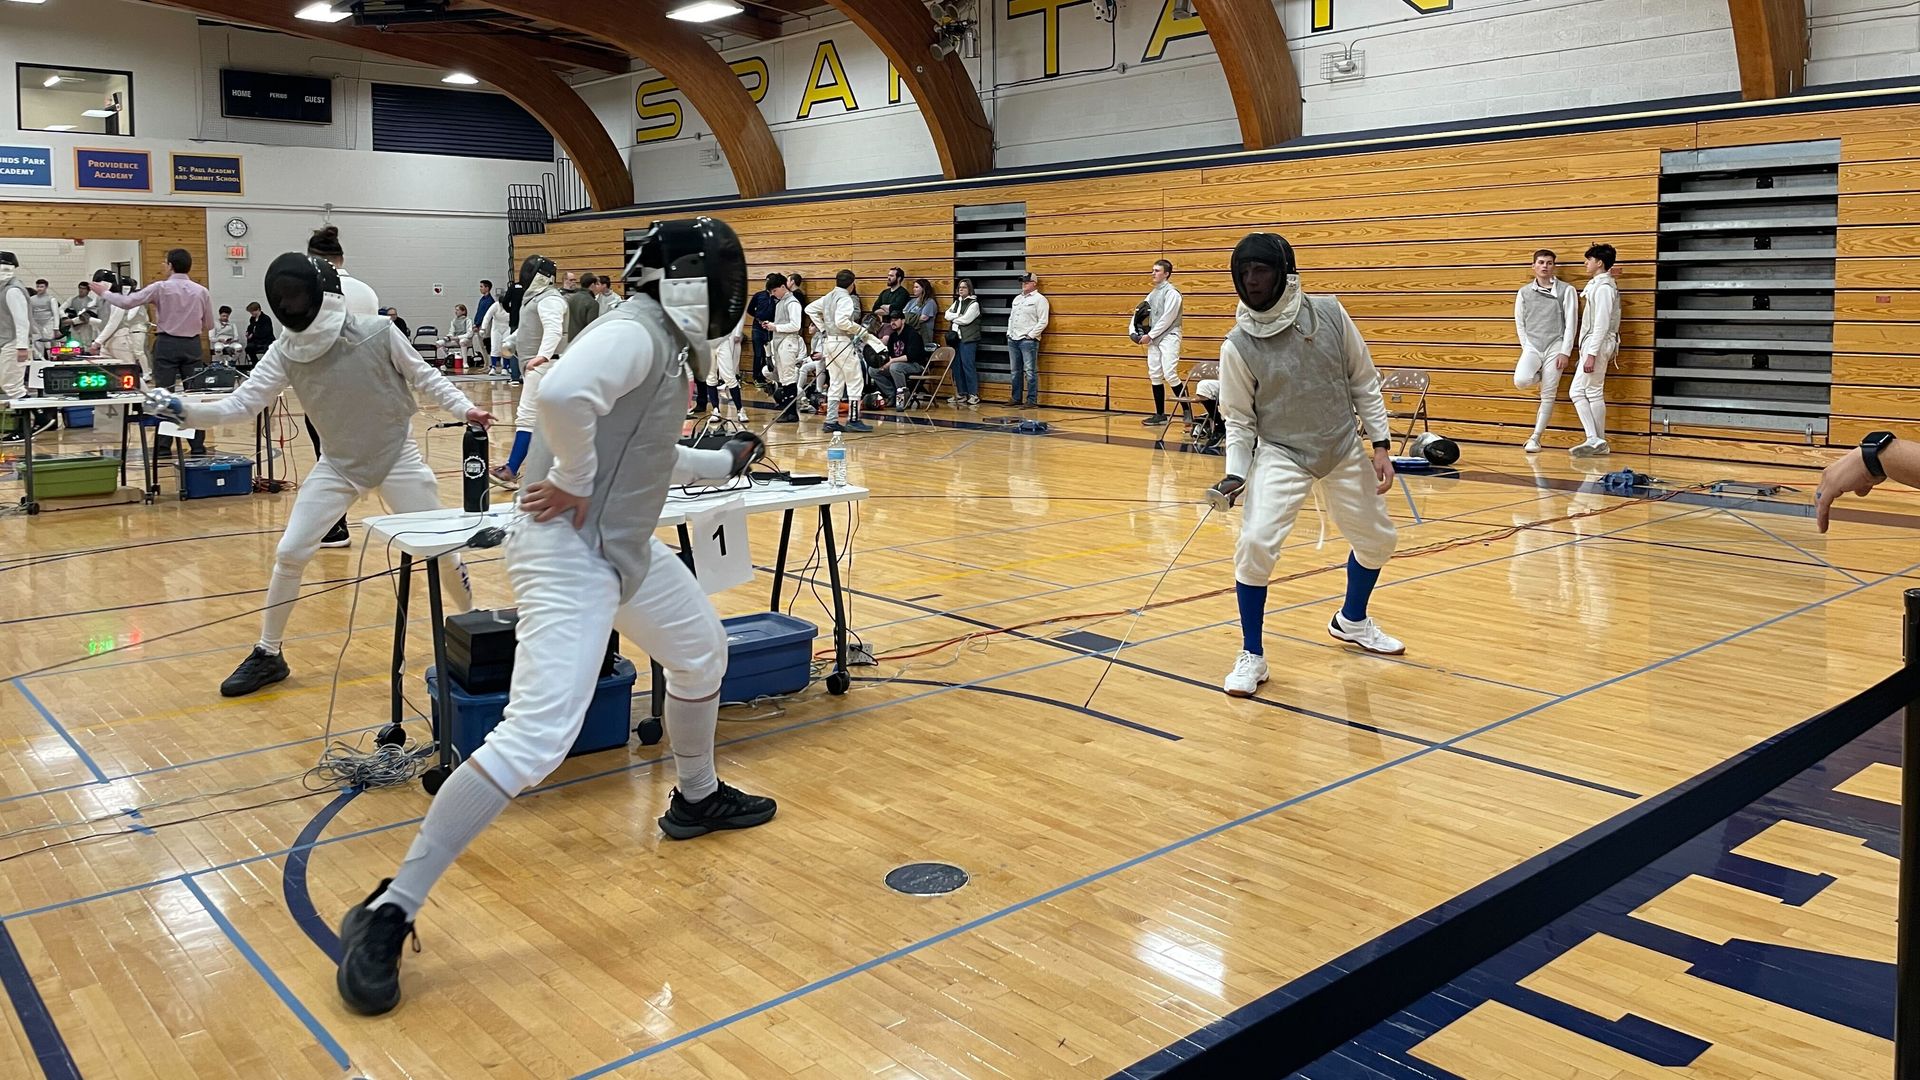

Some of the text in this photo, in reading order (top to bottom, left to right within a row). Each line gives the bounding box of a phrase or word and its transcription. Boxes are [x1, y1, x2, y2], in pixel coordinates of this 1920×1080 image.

[232, 89, 252, 98] HOME
[304, 95, 325, 104] GUEST
[22, 156, 46, 165] PARK
[88, 160, 139, 169] PROVIDENCE
[94, 171, 134, 179] ACADEMY
[712, 524, 727, 557] 1
